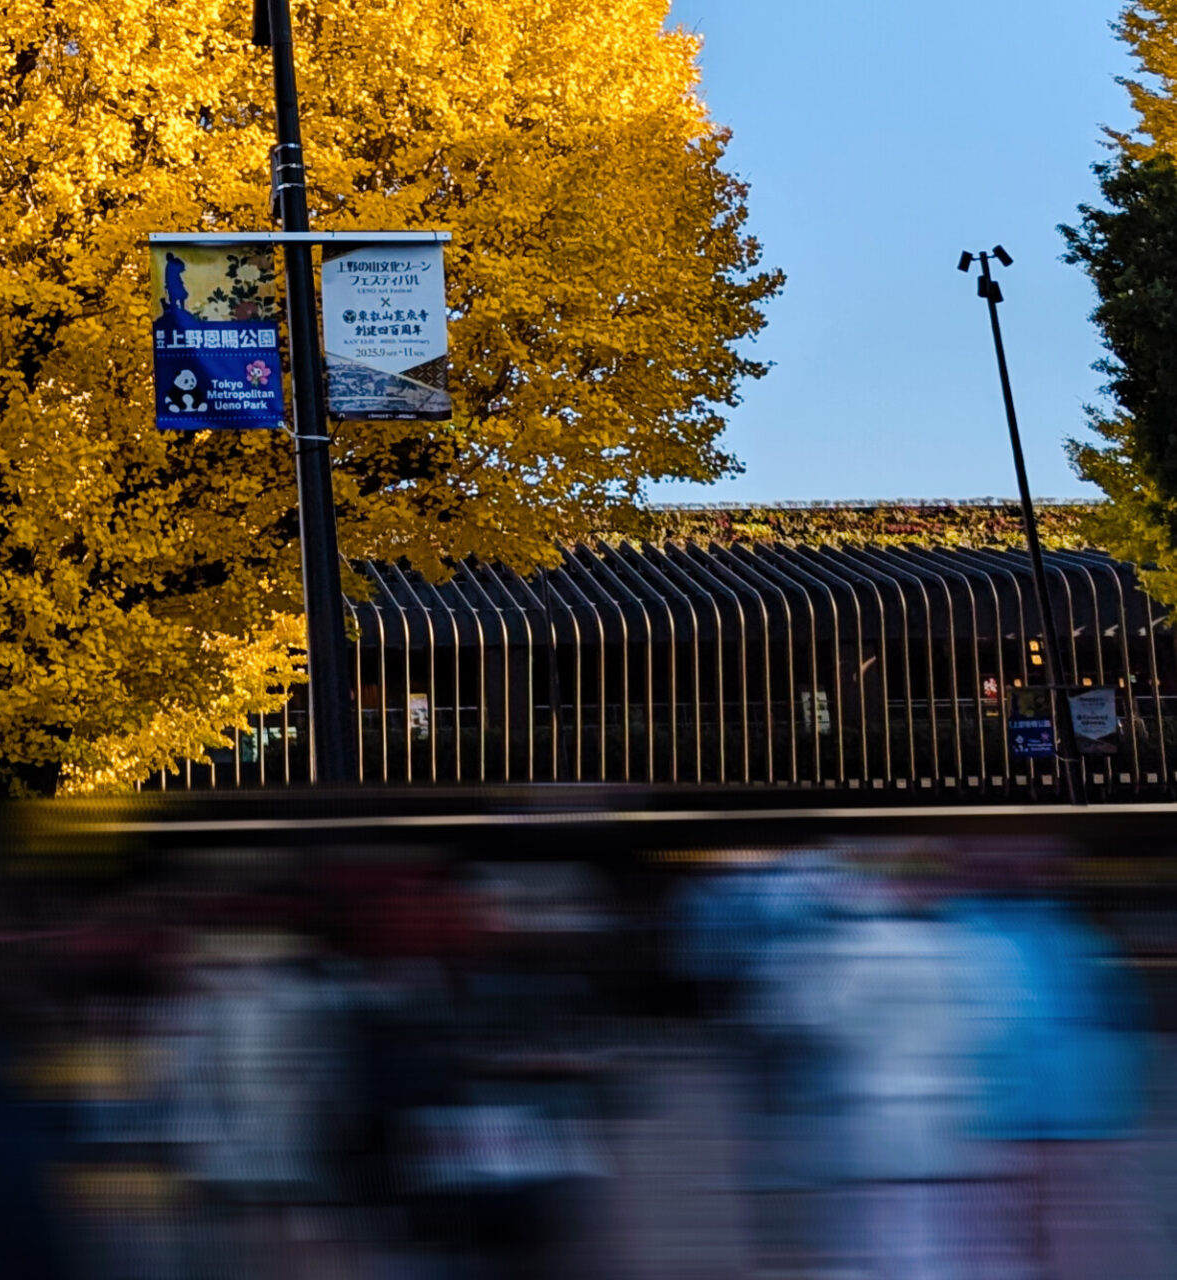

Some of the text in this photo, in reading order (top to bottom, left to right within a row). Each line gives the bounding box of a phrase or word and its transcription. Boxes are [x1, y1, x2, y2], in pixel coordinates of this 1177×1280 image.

[336, 261, 431, 273] 上野の山文化ゾーン
[350, 274, 420, 286] フェスティバル
[167, 329, 277, 349] 上野恩賜公園
[211, 379, 243, 390] Tokyo
[207, 389, 275, 400] Metropolitan
[215, 400, 268, 410] Ueno Park
